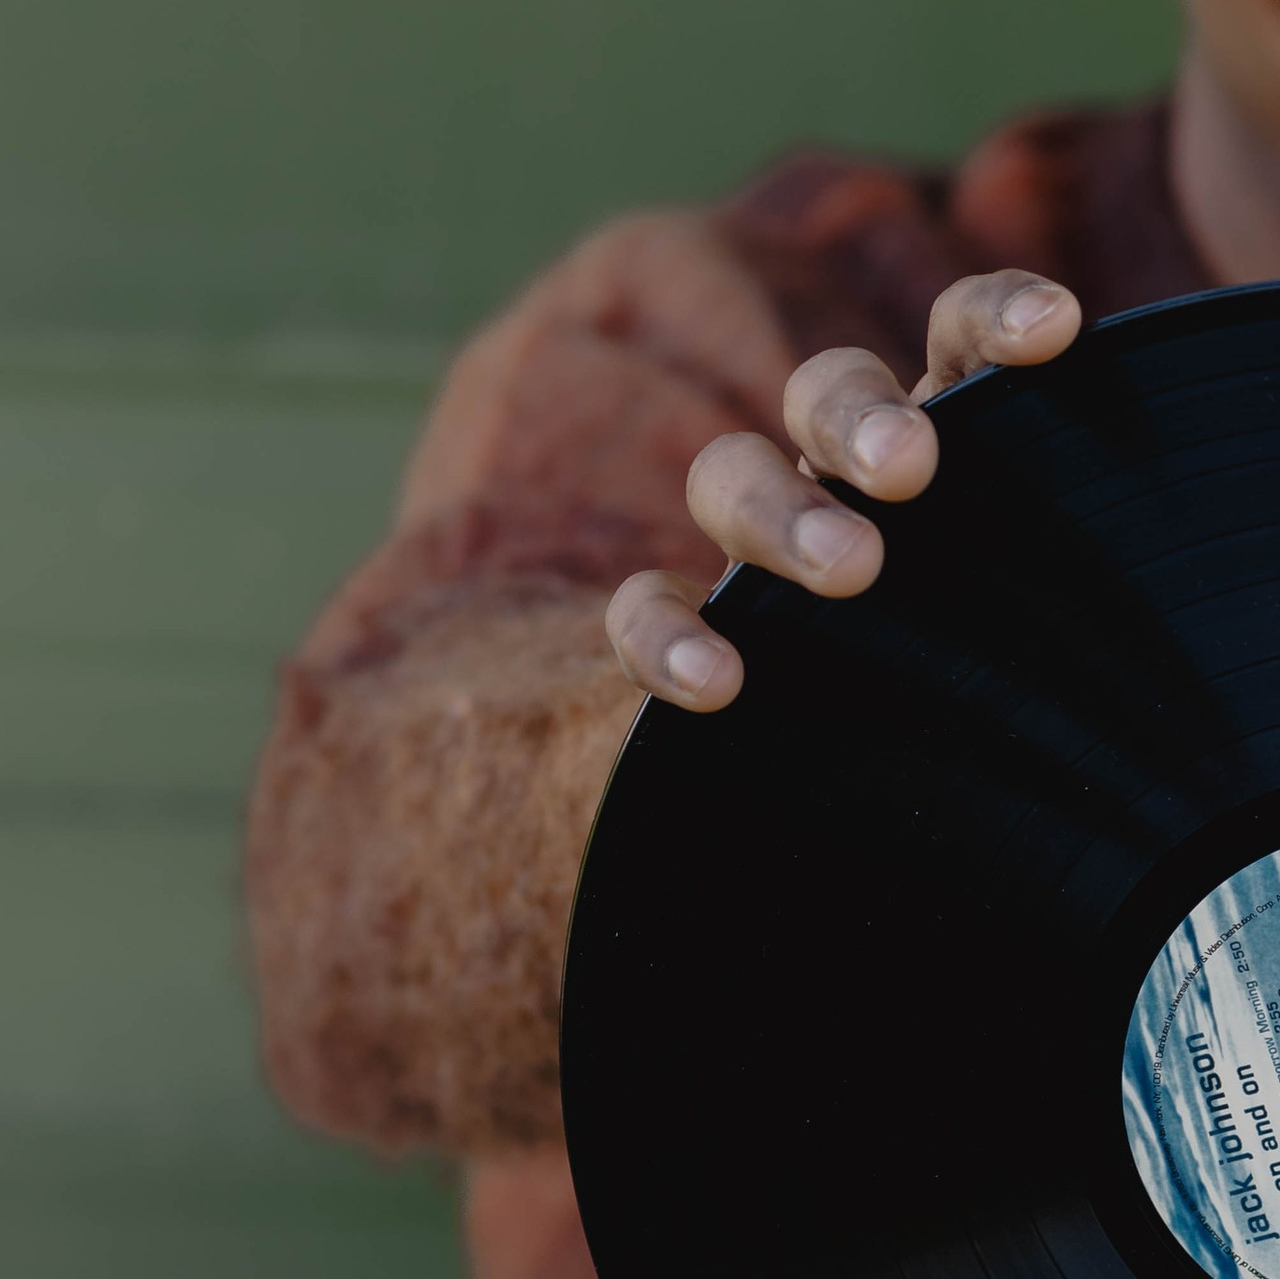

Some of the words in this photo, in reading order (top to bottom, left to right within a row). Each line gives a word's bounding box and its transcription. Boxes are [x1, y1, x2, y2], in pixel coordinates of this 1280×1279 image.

[1197, 955, 1209, 963] &
[1204, 939, 1223, 956] Video
[1229, 940, 1249, 973] 2:50
[1184, 959, 1204, 981] Music
[1168, 980, 1189, 1012] Universal
[1245, 980, 1270, 1033] Morning
[1164, 1011, 1176, 1021] by
[1154, 1020, 1171, 1058] Distributed
[1236, 1064, 1259, 1095] on
[1186, 1033, 1252, 1164] johnson
[1243, 1104, 1278, 1151] and
[1229, 1173, 1280, 1244] jack
[1222, 1244, 1242, 1263] UMG
[1238, 1260, 1248, 1268] of
